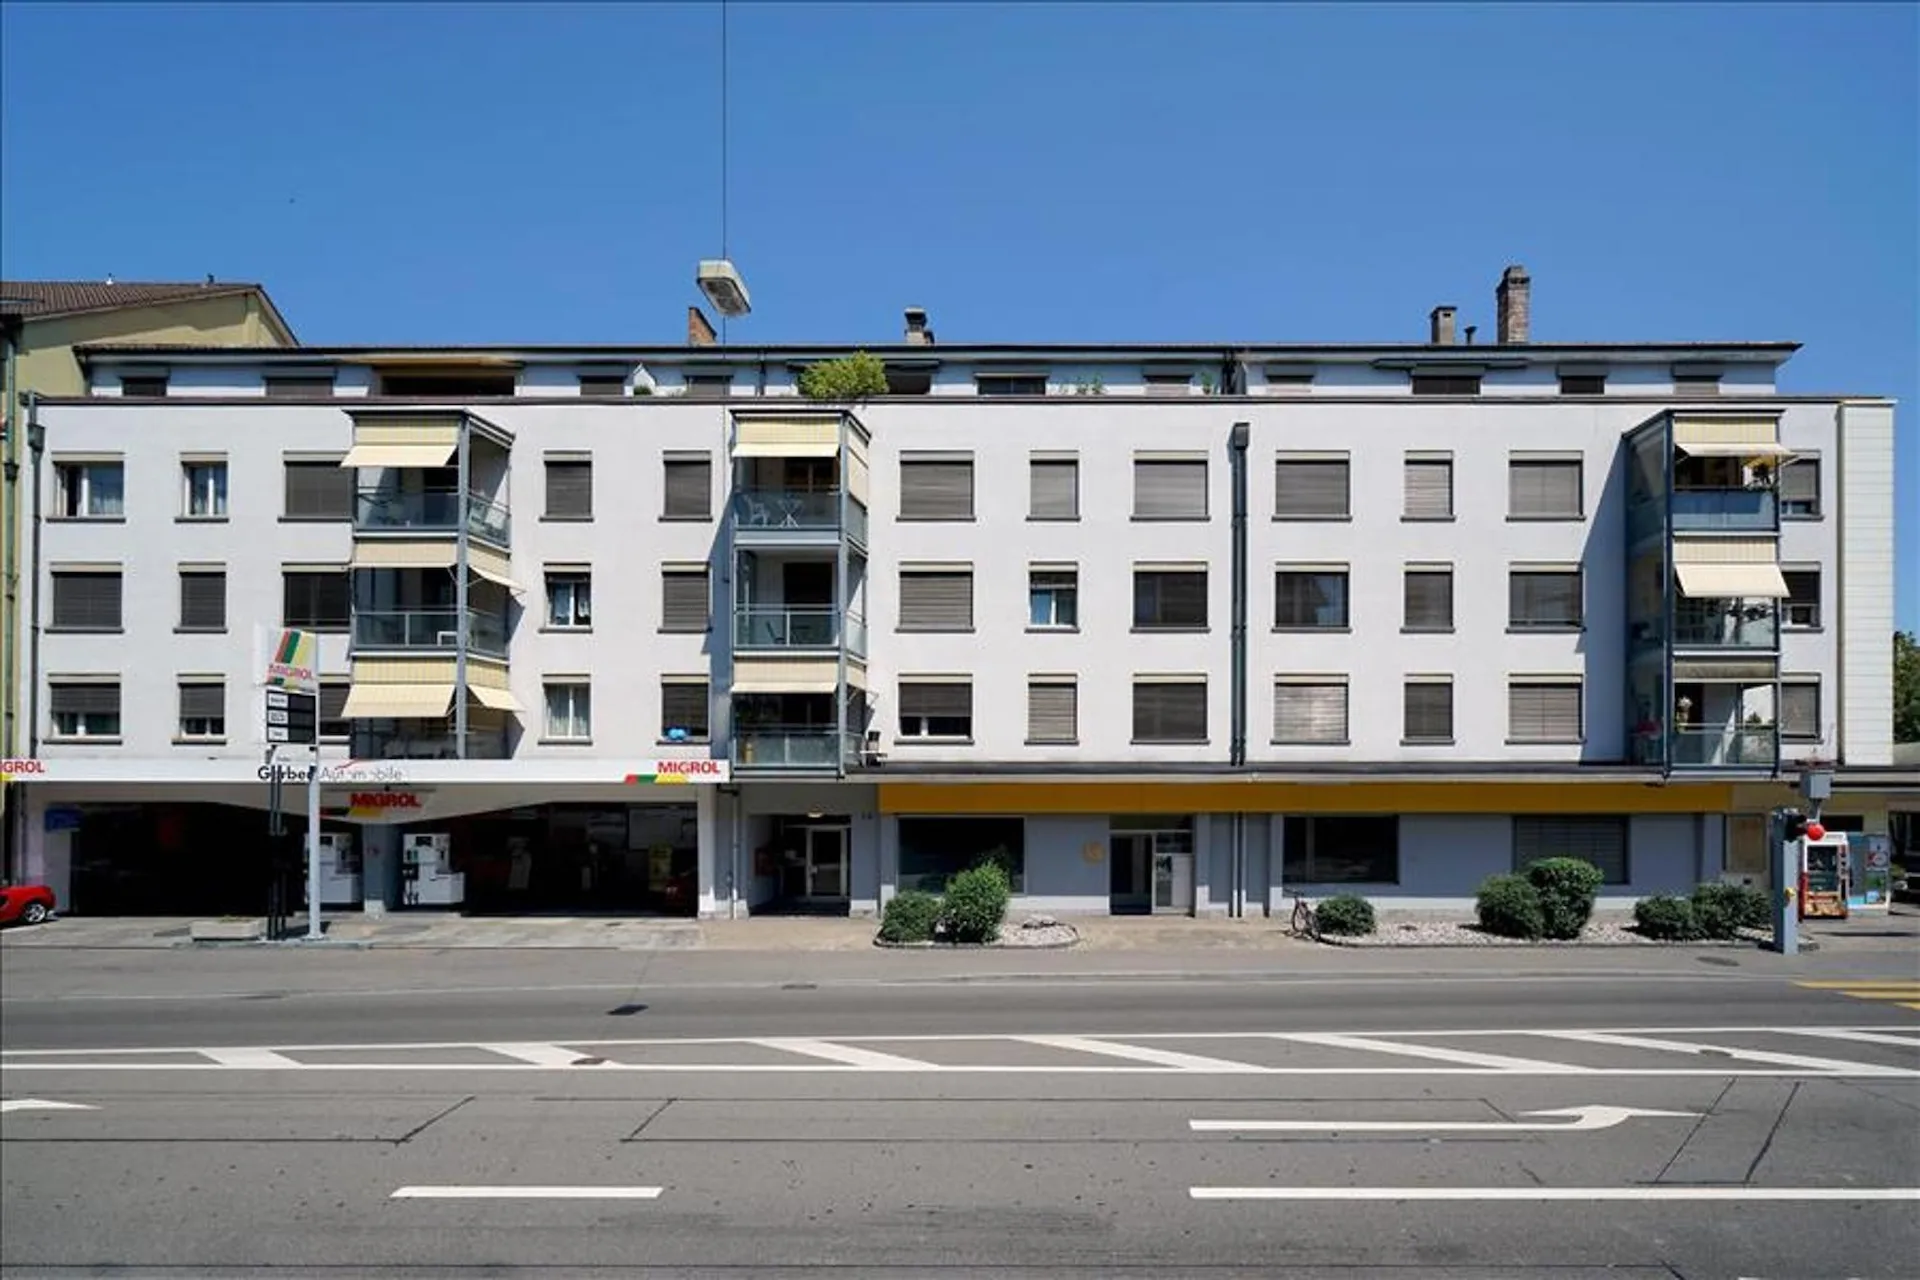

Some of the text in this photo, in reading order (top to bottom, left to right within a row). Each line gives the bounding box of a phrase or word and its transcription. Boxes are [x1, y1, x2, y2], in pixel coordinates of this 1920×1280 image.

[257, 765, 314, 780] Grbe
[657, 761, 720, 774] MIGROL
[350, 792, 422, 807] MIGROL
